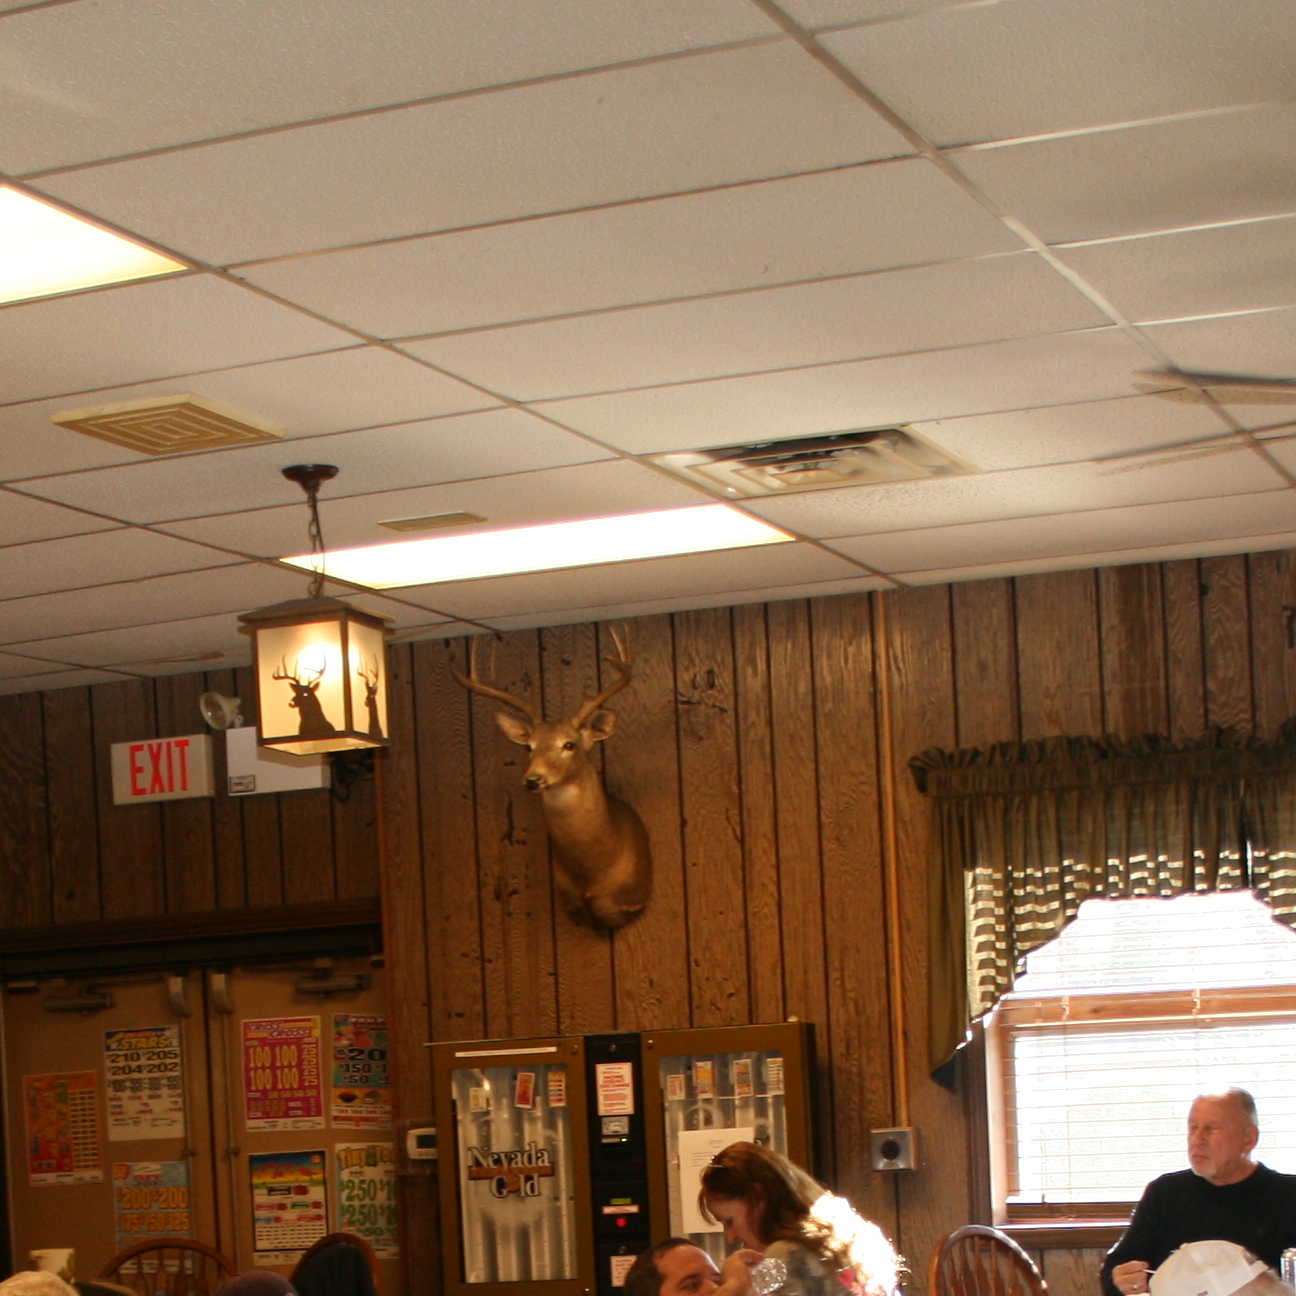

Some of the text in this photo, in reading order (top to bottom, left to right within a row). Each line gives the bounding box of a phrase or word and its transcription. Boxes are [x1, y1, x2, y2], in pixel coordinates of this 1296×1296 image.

[128, 739, 190, 796] EXIT
[121, 1036, 169, 1050] STARS
[249, 1045, 298, 1068] 100 100
[249, 1068, 299, 1090] 100 100
[468, 1140, 552, 1170] Nevada
